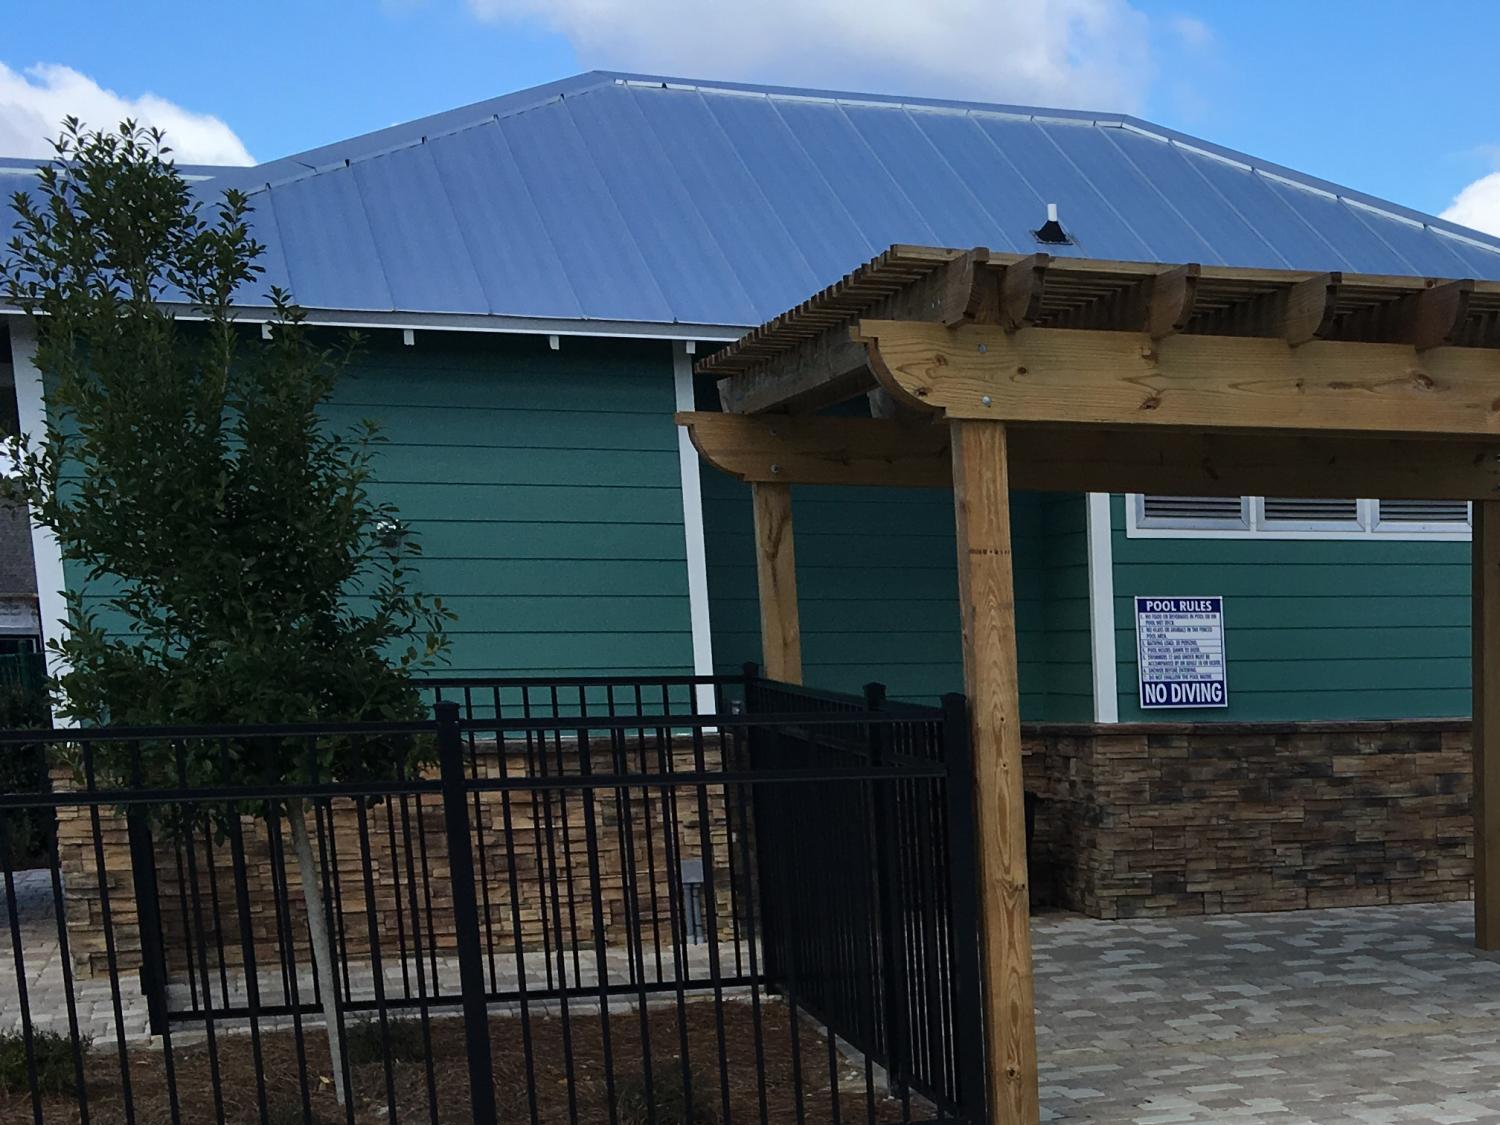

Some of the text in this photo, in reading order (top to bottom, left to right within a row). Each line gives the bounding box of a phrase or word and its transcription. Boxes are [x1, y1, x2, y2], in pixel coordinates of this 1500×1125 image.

[1146, 600, 1212, 612] POOL RULES
[1145, 682, 1222, 703] NO DIVING
